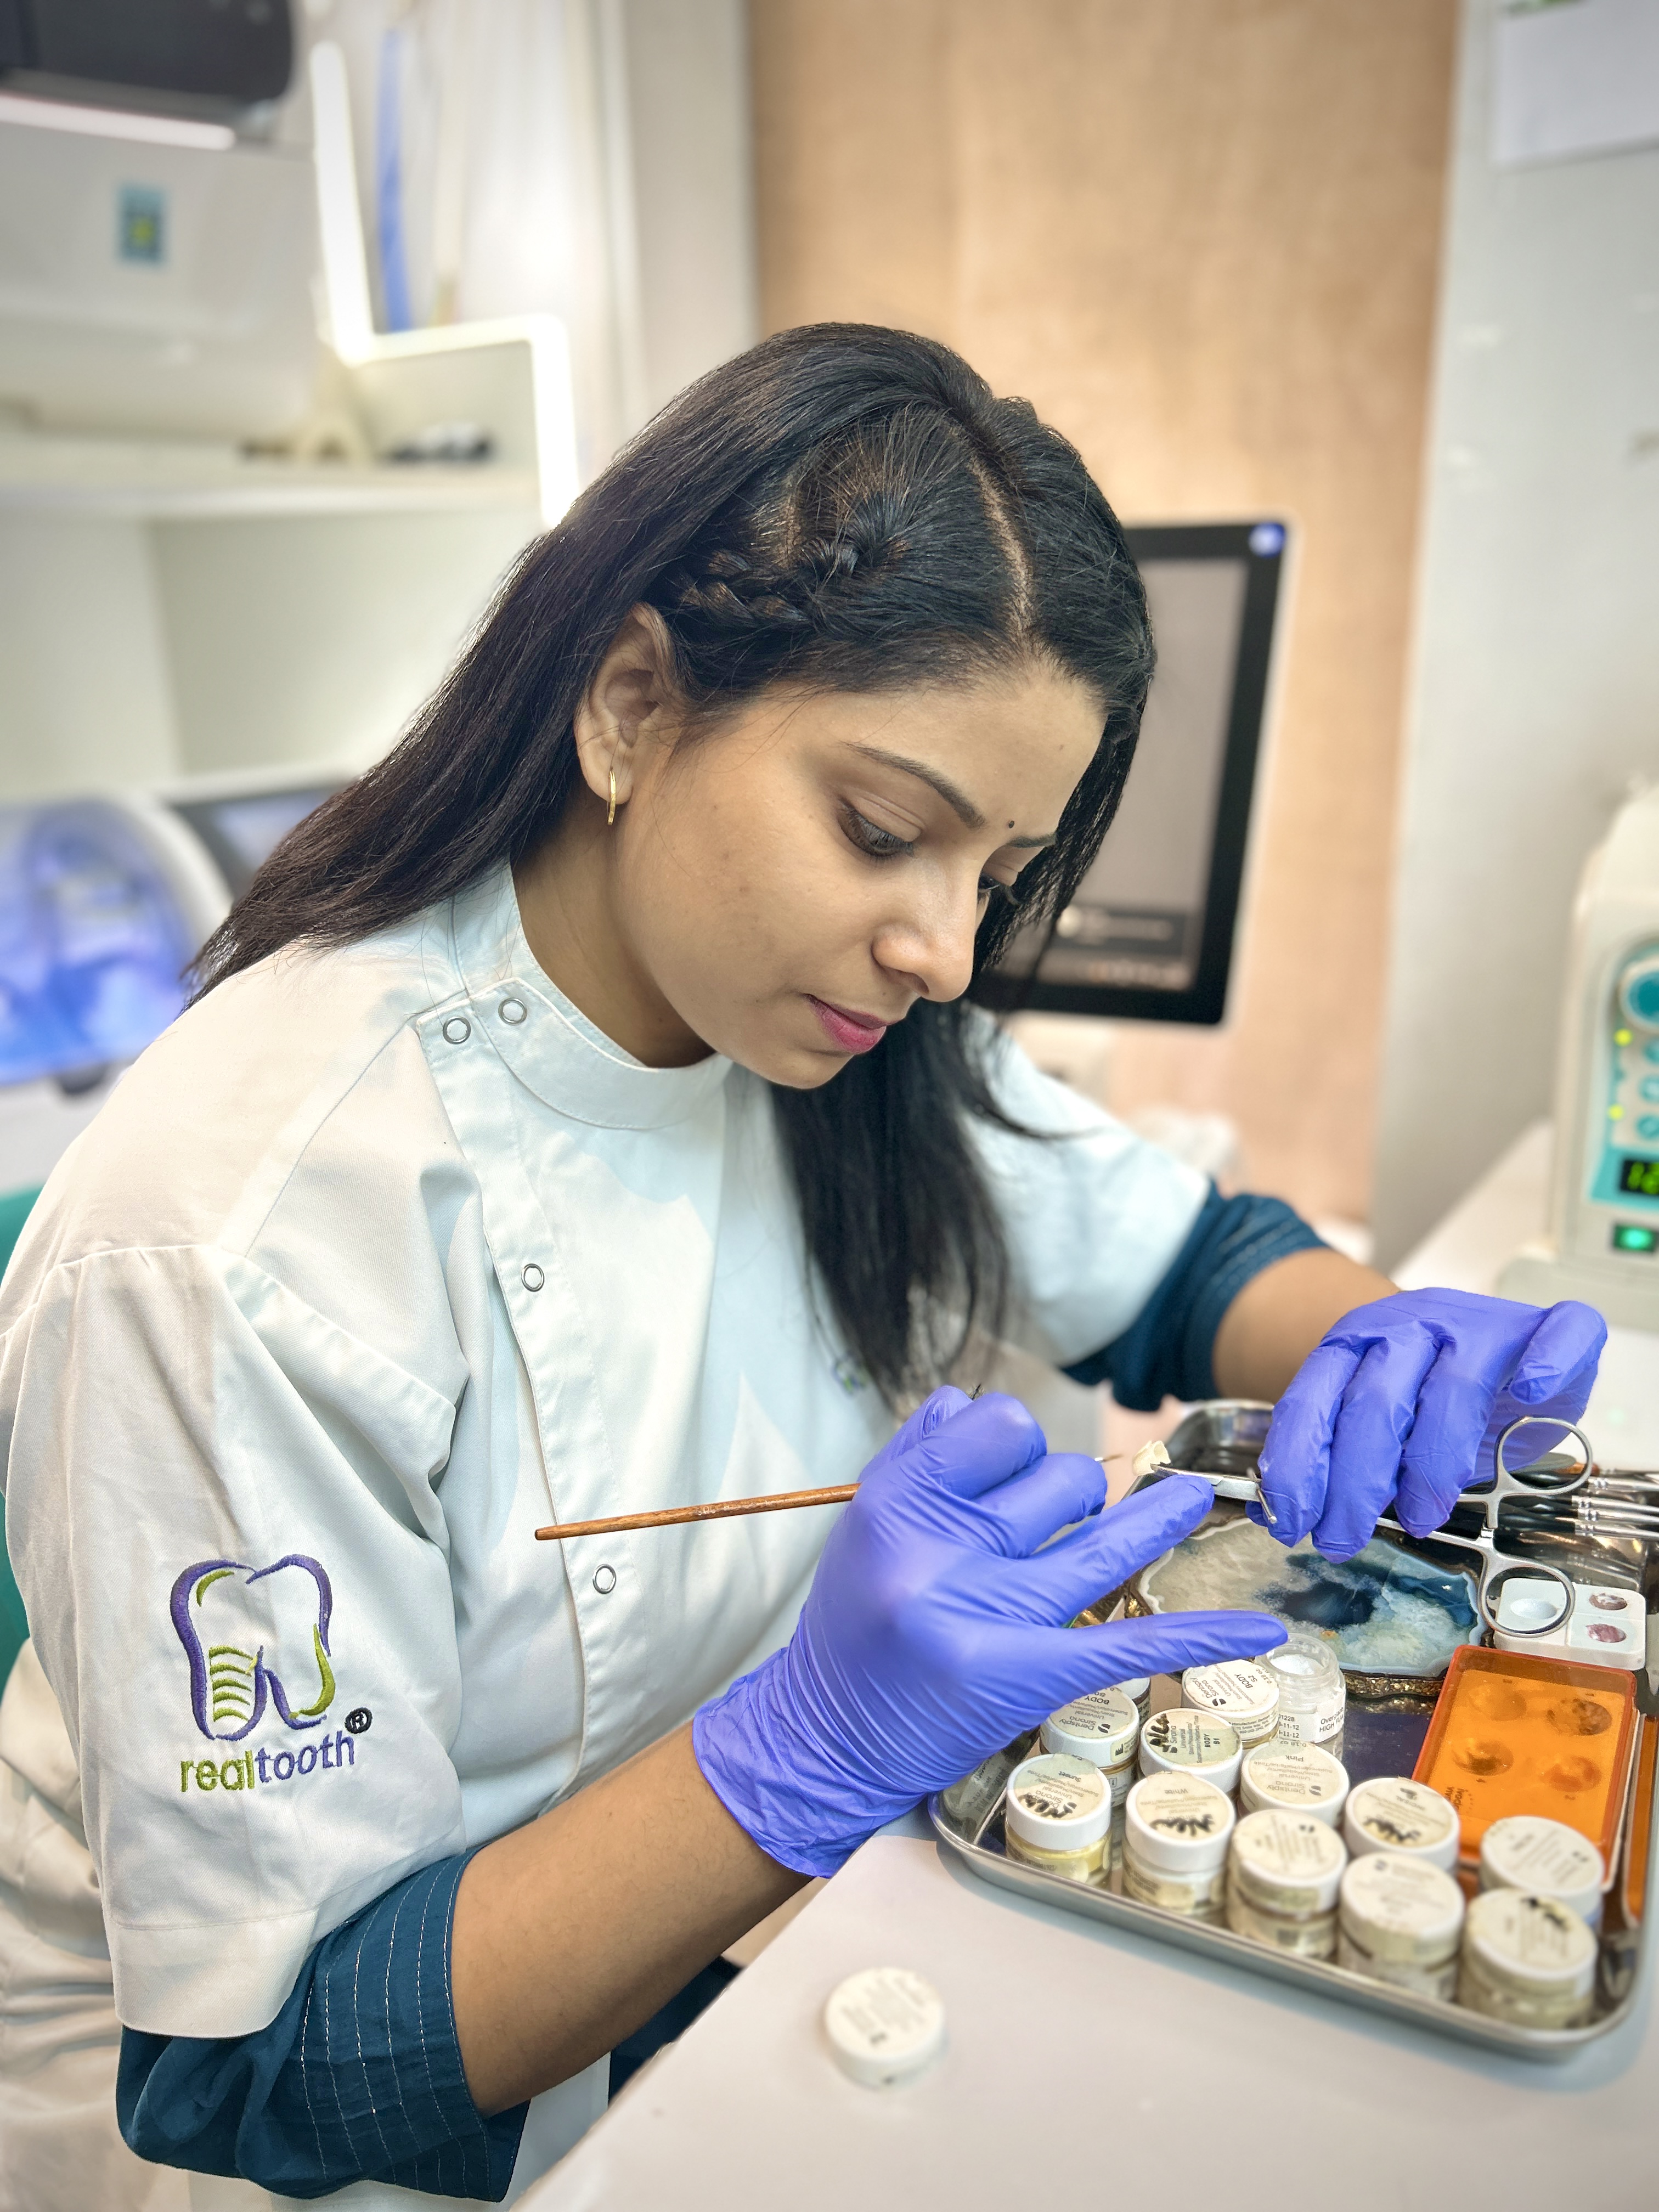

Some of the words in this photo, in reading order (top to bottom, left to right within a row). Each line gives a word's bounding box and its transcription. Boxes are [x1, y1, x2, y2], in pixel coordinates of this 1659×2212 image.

[1234, 1674, 1254, 1689] BODY
[1084, 1696, 1110, 1705] BODY
[1059, 1718, 1094, 1731] Dentsply
[1069, 1716, 1097, 1726] Sirona
[1319, 1723, 1335, 1733] HIGH
[180, 1730, 355, 1792] realtooth
[1058, 1771, 1081, 1782] Sunset
[1266, 1785, 1305, 1795] Dentsply
[1276, 1781, 1305, 1789] Sirona
[1035, 1790, 1063, 1803] Sirona
[1042, 1786, 1072, 1799] Universal
